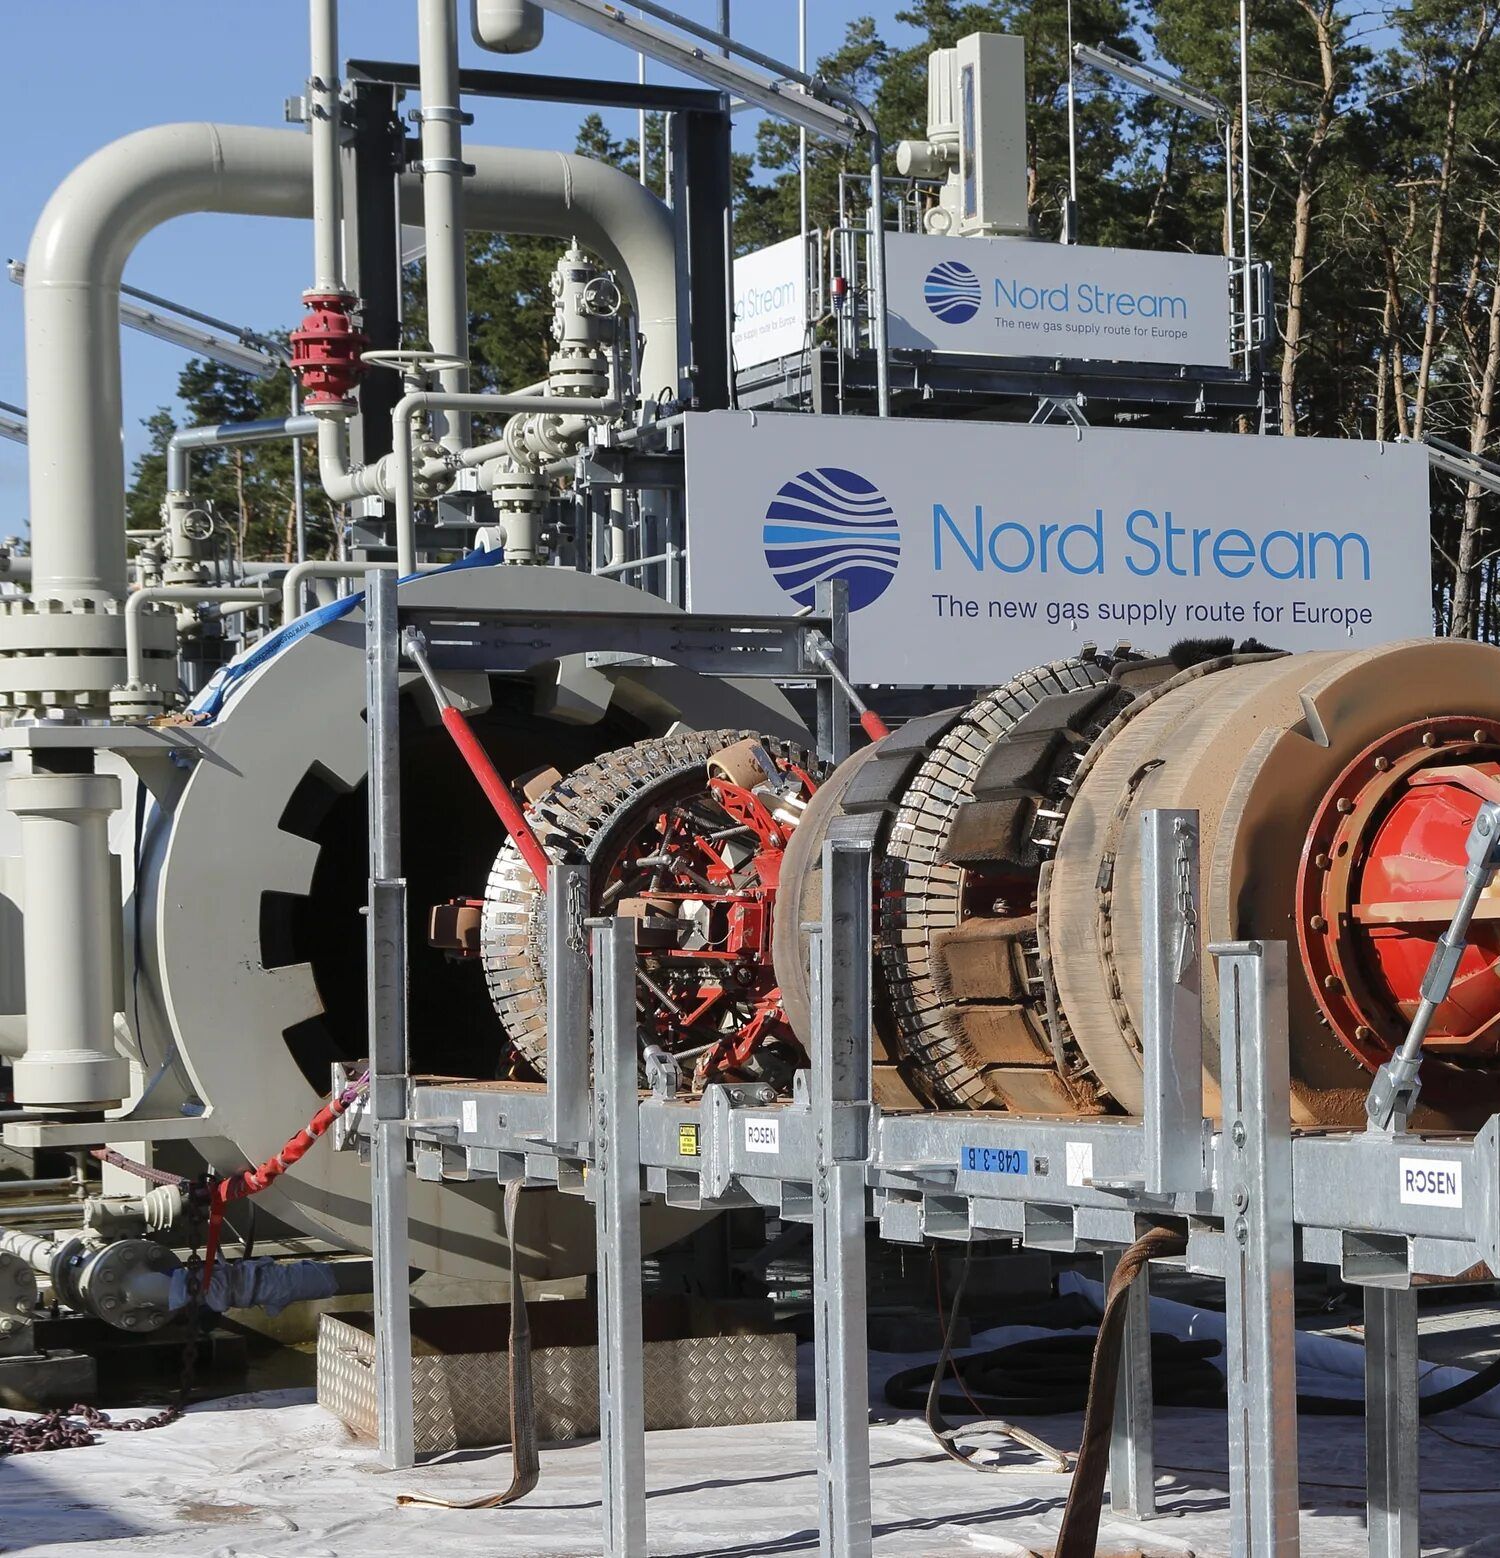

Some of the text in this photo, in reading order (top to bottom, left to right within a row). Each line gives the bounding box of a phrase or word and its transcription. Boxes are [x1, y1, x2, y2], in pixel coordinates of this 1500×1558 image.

[747, 282, 796, 318] Stream
[994, 278, 1187, 319] Nord Stream
[994, 317, 1188, 340] The new gas supply route for Europe
[932, 503, 1371, 581] Nord Stream
[932, 594, 1373, 629] The new gas supply route for Europe
[748, 1126, 776, 1145] ROSEN
[1405, 1169, 1456, 1195] ROSEN
